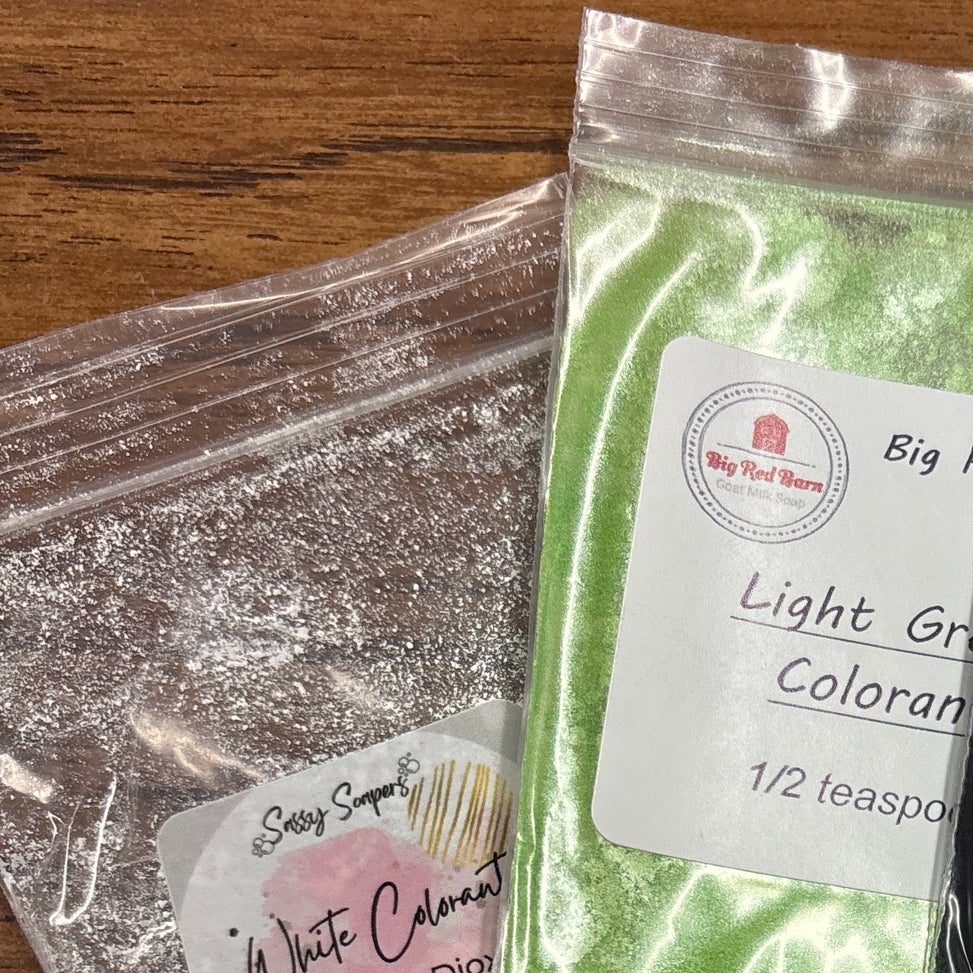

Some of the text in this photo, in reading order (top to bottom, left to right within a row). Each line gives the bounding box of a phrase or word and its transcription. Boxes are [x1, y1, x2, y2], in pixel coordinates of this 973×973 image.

[706, 450, 824, 493] Big Red Barn
[884, 434, 940, 475] Big
[716, 478, 806, 511] Goat Milk Soap
[740, 571, 875, 632] Light
[263, 776, 410, 845] Sassy Soapers
[750, 760, 956, 825] 1/2 teaspo
[371, 851, 507, 963] Colorant
